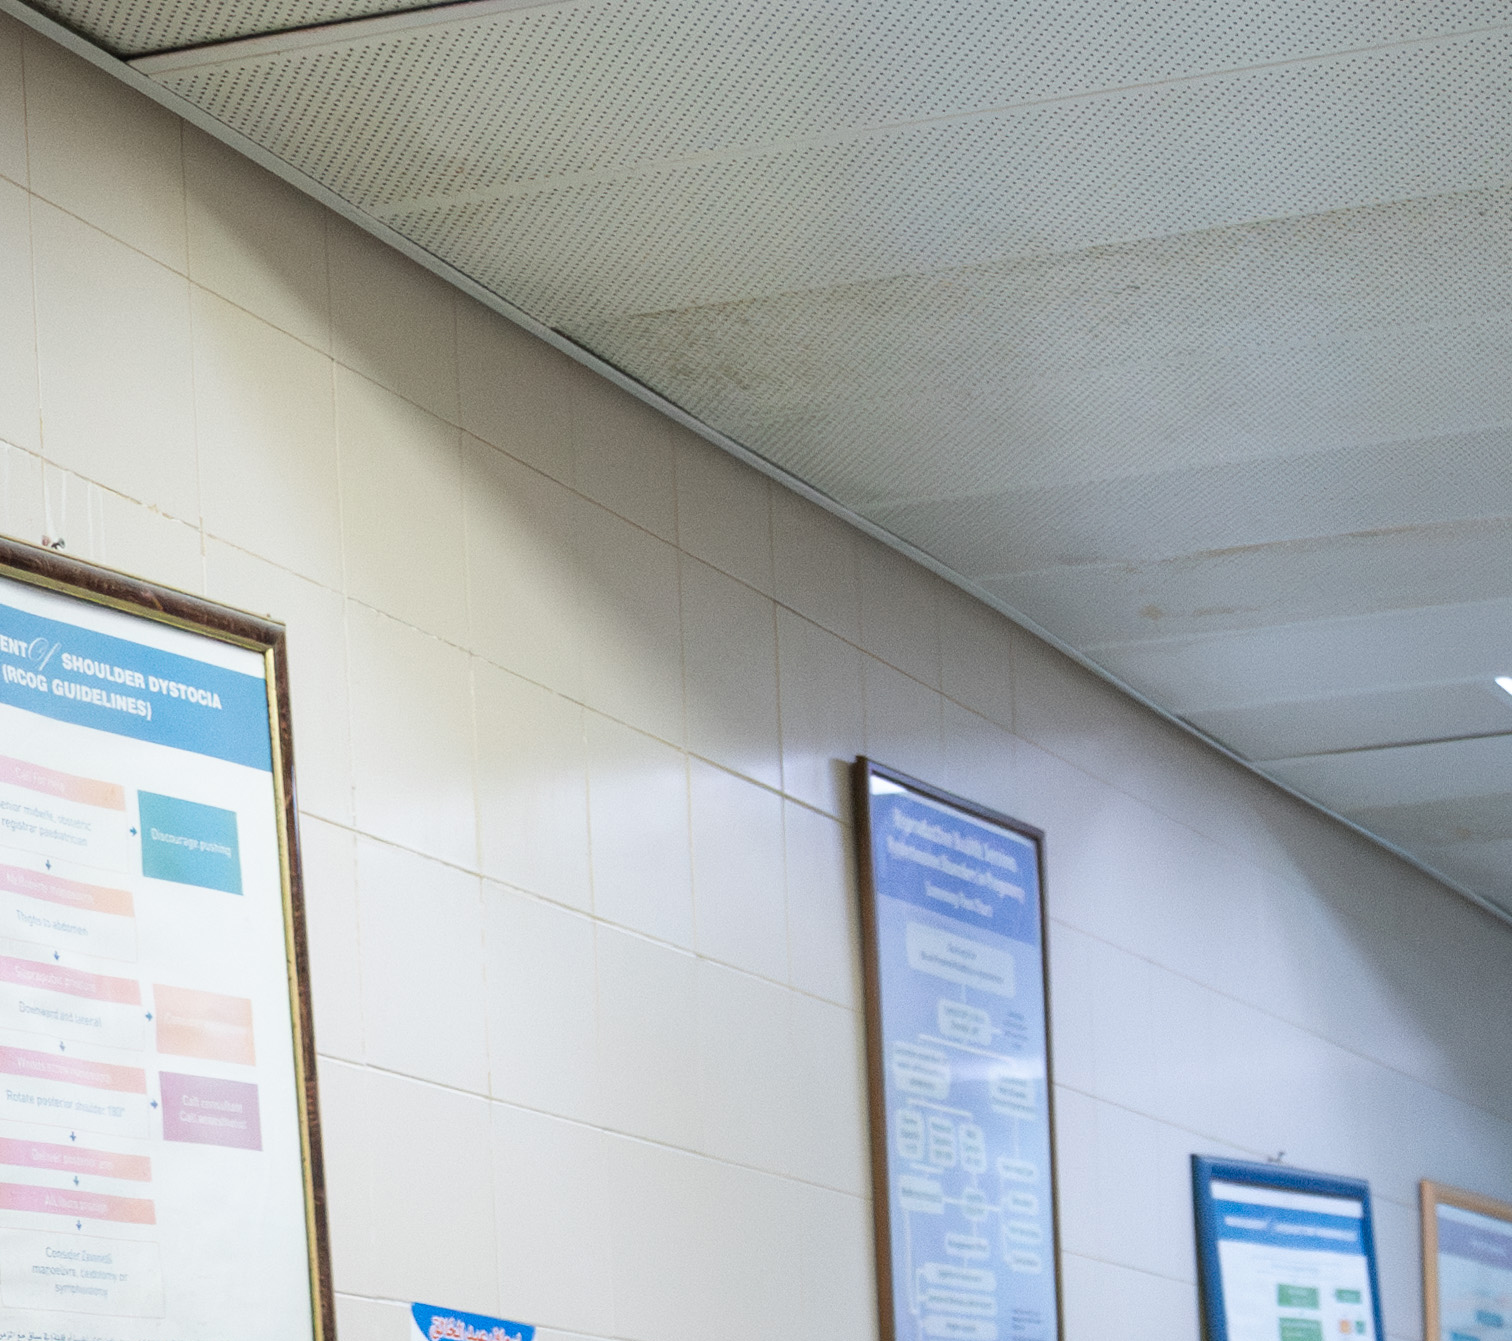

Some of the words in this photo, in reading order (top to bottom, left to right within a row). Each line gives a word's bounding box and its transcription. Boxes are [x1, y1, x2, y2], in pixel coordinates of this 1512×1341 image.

[1, 663, 49, 693] (RCOG
[51, 678, 153, 721] GUIDELINES)
[61, 652, 146, 689] SHOULDER
[148, 677, 223, 710] DYSTOCIA
[150, 827, 199, 851] Discourage
[199, 840, 232, 860] pushing
[5, 1088, 36, 1105] Rotate
[36, 1095, 73, 1110] posterior
